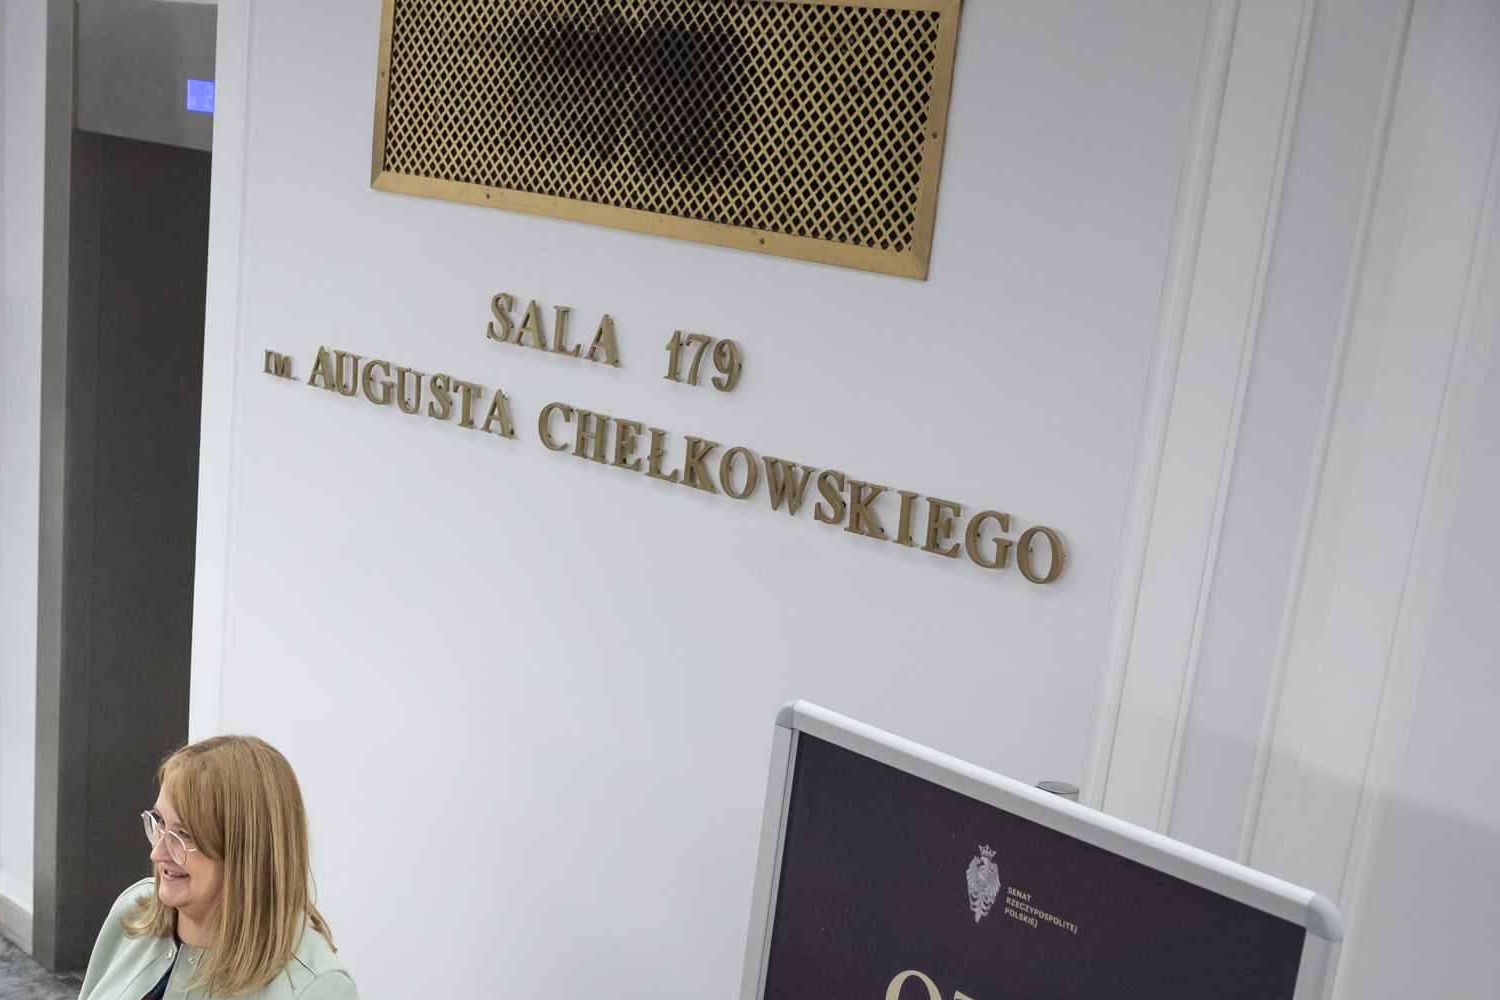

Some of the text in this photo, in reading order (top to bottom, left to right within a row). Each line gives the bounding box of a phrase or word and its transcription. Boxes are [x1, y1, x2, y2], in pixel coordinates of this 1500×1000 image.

[485, 291, 743, 394] SALA 179
[263, 344, 1069, 586] IM. AUGUSTA CHEŁKOWSKIEGO
[1007, 886, 1032, 902] SENAT
[1004, 907, 1038, 929] POLSKIEJ
[1005, 896, 1078, 935] RZECZYPOSPOLITEJ
